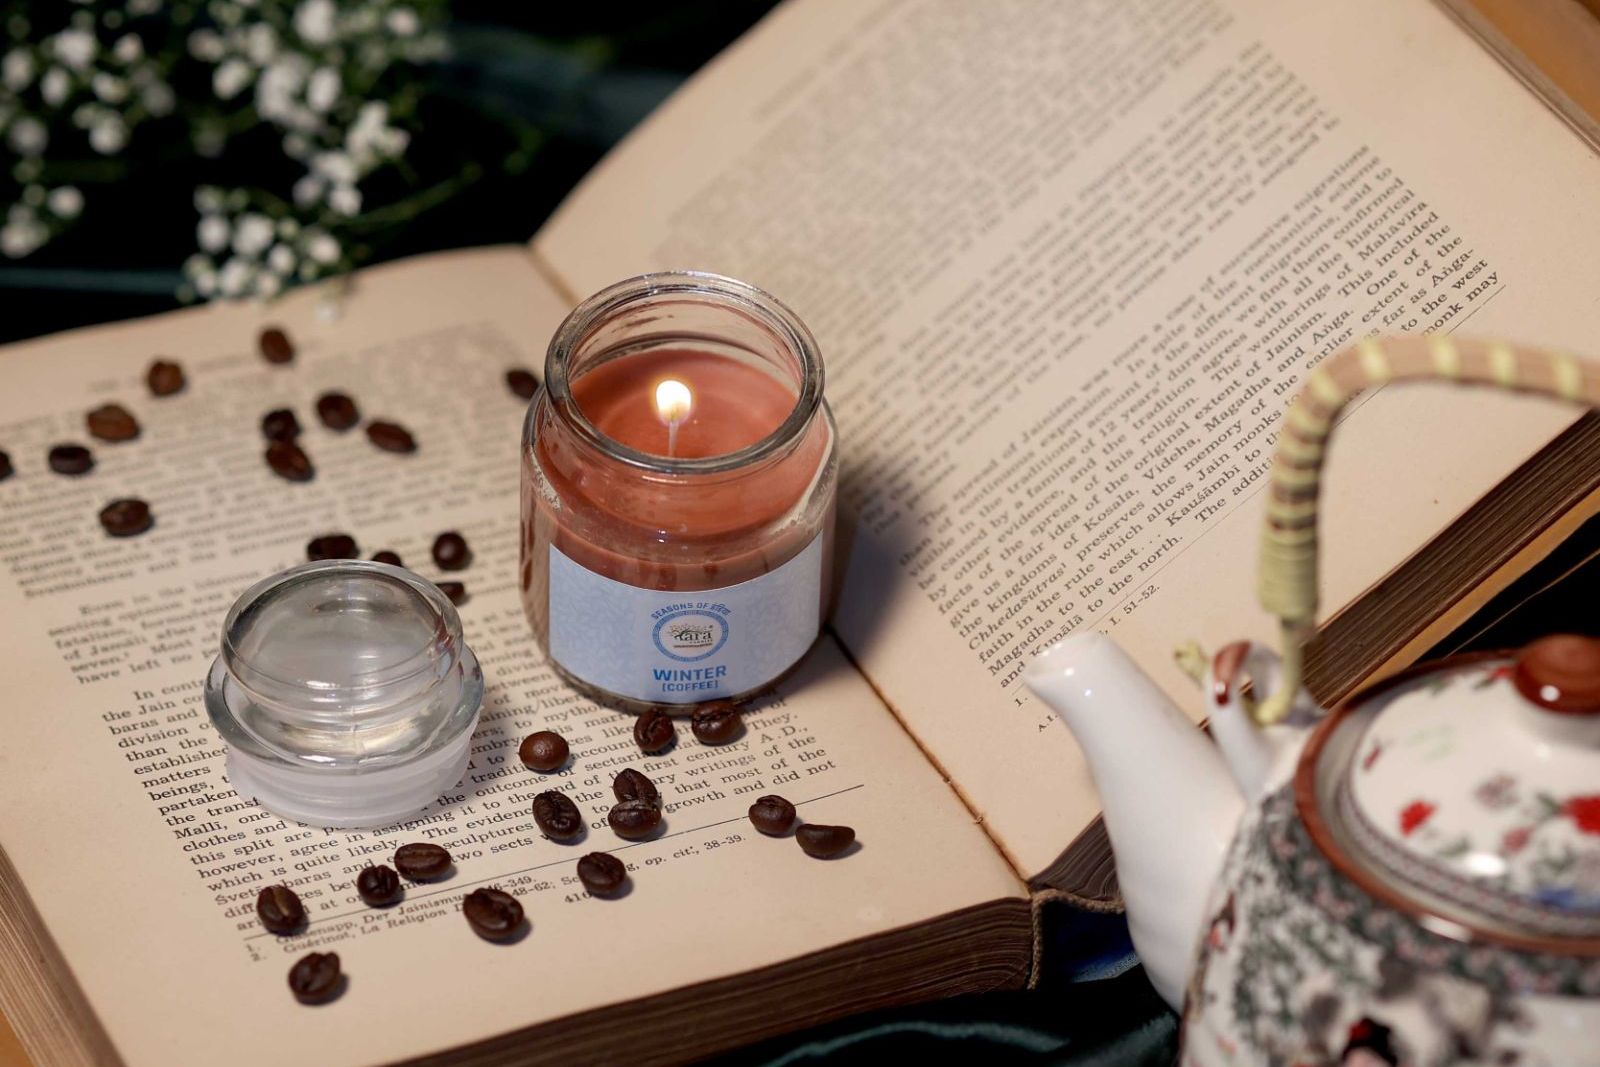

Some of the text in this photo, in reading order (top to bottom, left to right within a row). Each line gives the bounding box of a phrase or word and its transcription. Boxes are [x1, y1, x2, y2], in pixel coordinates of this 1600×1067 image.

[1243, 156, 1380, 276] mechanical scheme
[1293, 145, 1369, 211] migrations
[953, 188, 1415, 581] other evidence, tradition agrees historical
[1006, 215, 1341, 494] traditional different migrations,
[1025, 455, 1077, 498] famine
[1098, 420, 1117, 438] 12
[1167, 328, 1234, 382] duration,
[1332, 176, 1404, 240] confirmed
[949, 210, 1440, 629] give fair idea the original extent Jainism. This included
[958, 615, 983, 638] the
[986, 552, 1058, 613] kingdoms
[1081, 489, 1140, 533] Kosala,
[1141, 437, 1202, 480] Videha,
[1202, 375, 1272, 433] Magadha
[1276, 345, 1307, 373] and
[1365, 268, 1399, 296] One
[1424, 224, 1451, 246] the
[1075, 500, 1145, 563] preserves
[1151, 474, 1177, 497] the
[1183, 418, 1242, 472] memory
[1272, 374, 1298, 396] the
[1305, 326, 1354, 370] earlier
[1361, 280, 1410, 323] extent
[1436, 235, 1463, 258] the
[937, 582, 974, 615] facts
[999, 539, 1024, 561] the
[1029, 492, 1078, 537] spread
[1104, 448, 1134, 473] this
[1139, 396, 1200, 445] religion.
[1247, 282, 1332, 353] wanderings
[978, 631, 1015, 665] faith
[1015, 614, 1035, 631] in
[1035, 590, 1062, 613] the
[1063, 562, 1096, 591] rule
[1097, 523, 1144, 561] which
[1146, 480, 1195, 523] allows
[1195, 452, 1232, 482] Jain
[1231, 408, 1282, 453] monks
[1381, 304, 1407, 327] far
[1408, 287, 1428, 305] as
[986, 618, 1055, 677] Magadha
[1057, 600, 1075, 616] to
[1078, 576, 1105, 599] the
[1243, 448, 1262, 465] to
[1399, 317, 1418, 332] to
[1420, 292, 1448, 316] the
[1450, 257, 1489, 290] west
[999, 659, 1027, 688] and
[1086, 597, 1104, 613] to
[1106, 570, 1137, 596] the
[1136, 535, 1184, 572] north.
[1191, 496, 1227, 523] The
[1464, 270, 1499, 303] may
[651, 602, 693, 620] SEASONS
[76, 659, 160, 684] have left
[101, 700, 177, 722] the Jain
[133, 690, 155, 701] In
[653, 665, 727, 682] WINTER
[107, 707, 199, 736] baras and
[117, 726, 189, 749] division
[124, 737, 208, 762] than the
[156, 720, 533, 817] partaken to
[140, 765, 212, 789] matters
[146, 780, 215, 802] beings,
[164, 813, 197, 827] the
[182, 738, 636, 852] clothes and account
[189, 770, 548, 865] this split are the outcome
[195, 853, 284, 879] however,
[289, 839, 340, 857] agree
[344, 828, 366, 843] in
[370, 809, 456, 837] assigning
[459, 804, 477, 816] it
[481, 800, 501, 811] to
[506, 791, 538, 804] the
[583, 773, 602, 787] of
[642, 757, 679, 773] first
[685, 740, 749, 762] century
[206, 736, 816, 892] which is quite likely. The evidenc the writings of the
[237, 808, 271, 824] one
[601, 725, 635, 739] like
[341, 749, 826, 874] and sculptures to that most of the
[449, 760, 836, 863] two sects of growth and did not
[319, 898, 338, 911] at
[362, 906, 393, 924] Der
[386, 908, 447, 929] Religion
[644, 856, 667, 866] op.
